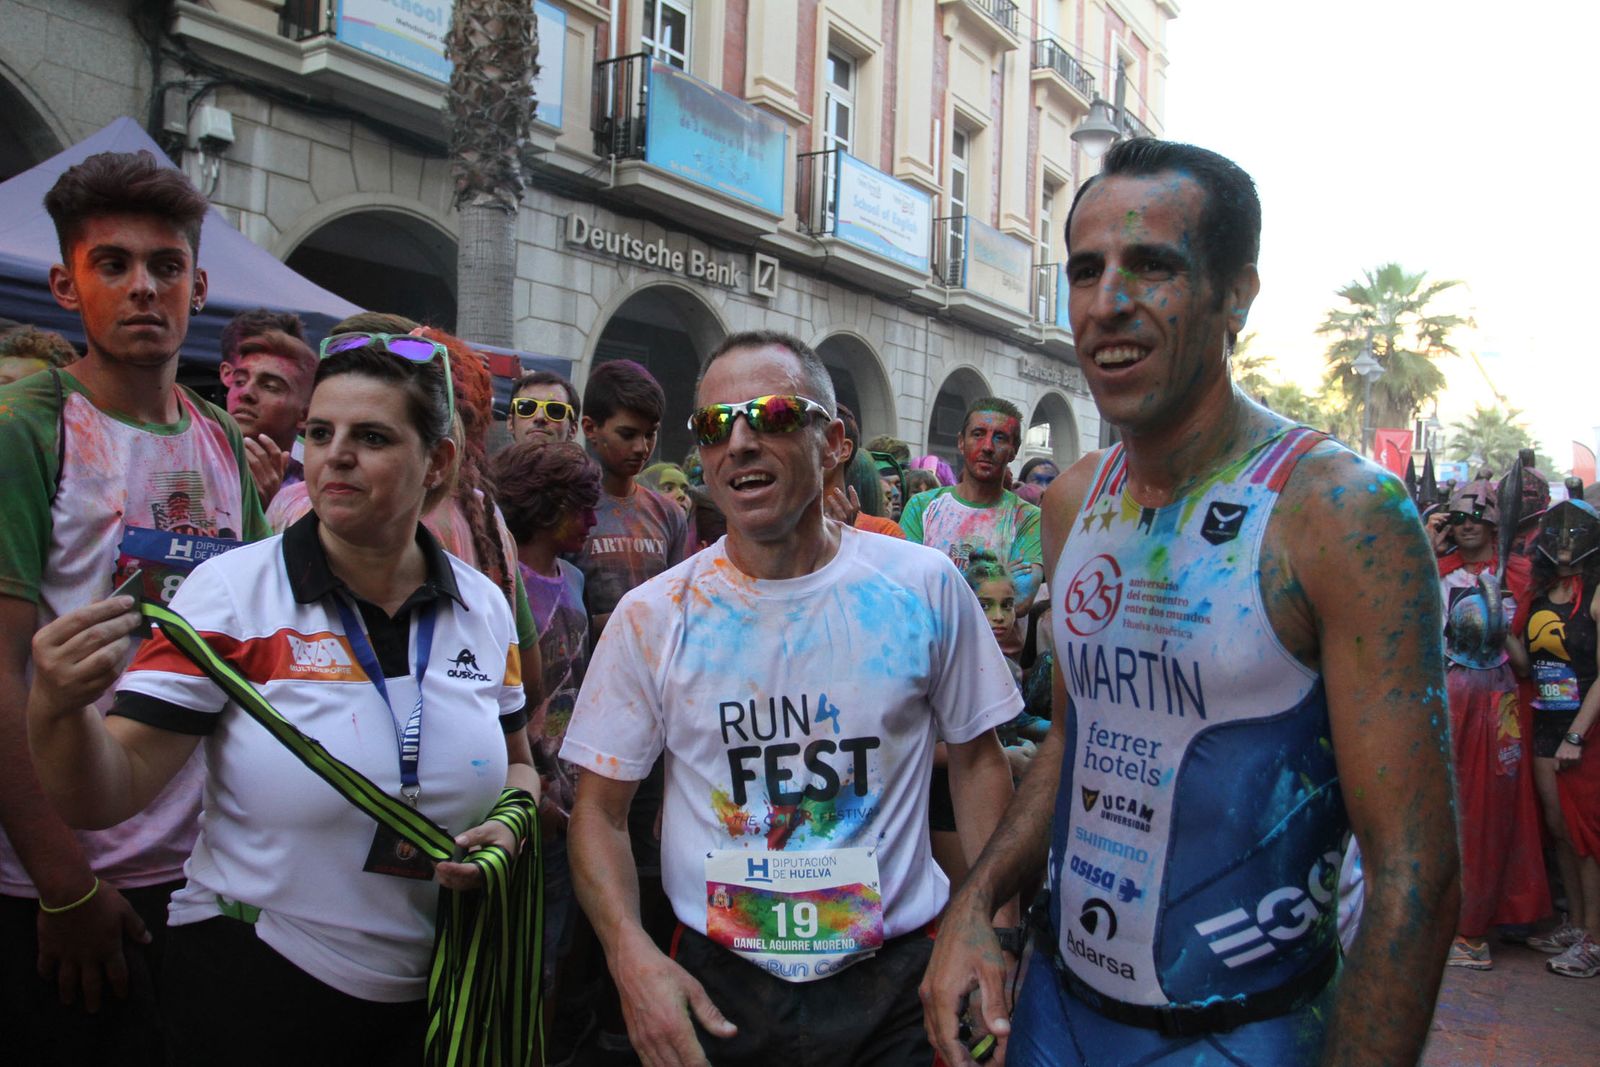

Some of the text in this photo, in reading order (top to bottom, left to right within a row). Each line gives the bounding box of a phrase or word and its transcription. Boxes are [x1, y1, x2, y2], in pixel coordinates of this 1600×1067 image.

[567, 213, 741, 287] Deutsche Bank
[1126, 590, 1190, 607] del encuentro
[1128, 577, 1179, 592] aniversario
[1124, 604, 1212, 625] entre dos mundos
[1068, 640, 1207, 720] MARTÍN
[1087, 721, 1162, 760] ferrer
[727, 736, 881, 807] FEST
[1083, 745, 1162, 787] hotels
[1100, 810, 1152, 833] UNIVERSIDAD
[1102, 794, 1155, 823] UCAM
[773, 855, 837, 868] DIPUTACIÓN
[1075, 826, 1149, 864] SHIMANO
[773, 867, 832, 880] DE HUELVA
[772, 901, 819, 939] 19
[733, 937, 856, 951] DANIEL AGUIRRE MORENO
[1067, 927, 1136, 982] Adarsa
